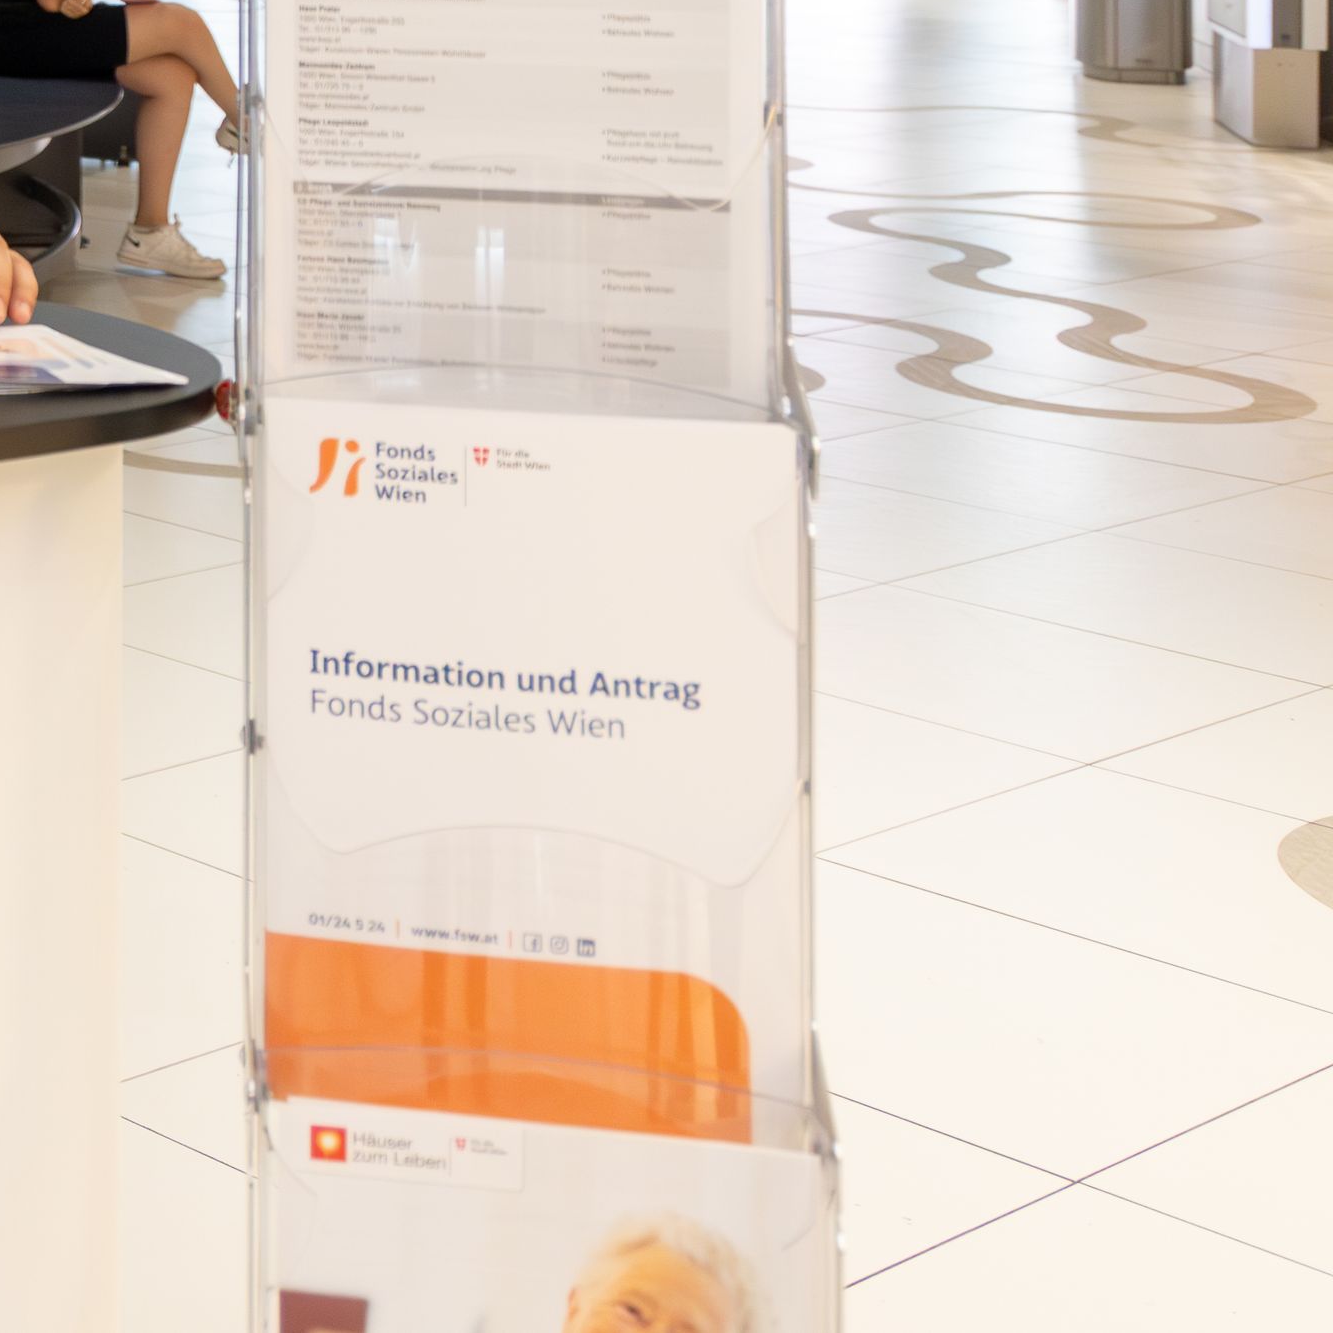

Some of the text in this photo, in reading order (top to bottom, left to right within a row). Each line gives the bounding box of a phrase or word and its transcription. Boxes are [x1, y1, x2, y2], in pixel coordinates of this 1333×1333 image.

[375, 442, 436, 461] Fonds
[375, 463, 458, 485] Soziales
[375, 484, 427, 503] Wien
[310, 648, 701, 710] Information und Antrag
[310, 689, 626, 740] Fonds Soziales Wien
[308, 913, 351, 930] 01/24
[368, 920, 386, 933] 24
[411, 925, 499, 945] www.fsw.at
[352, 1131, 413, 1151] Häuser
